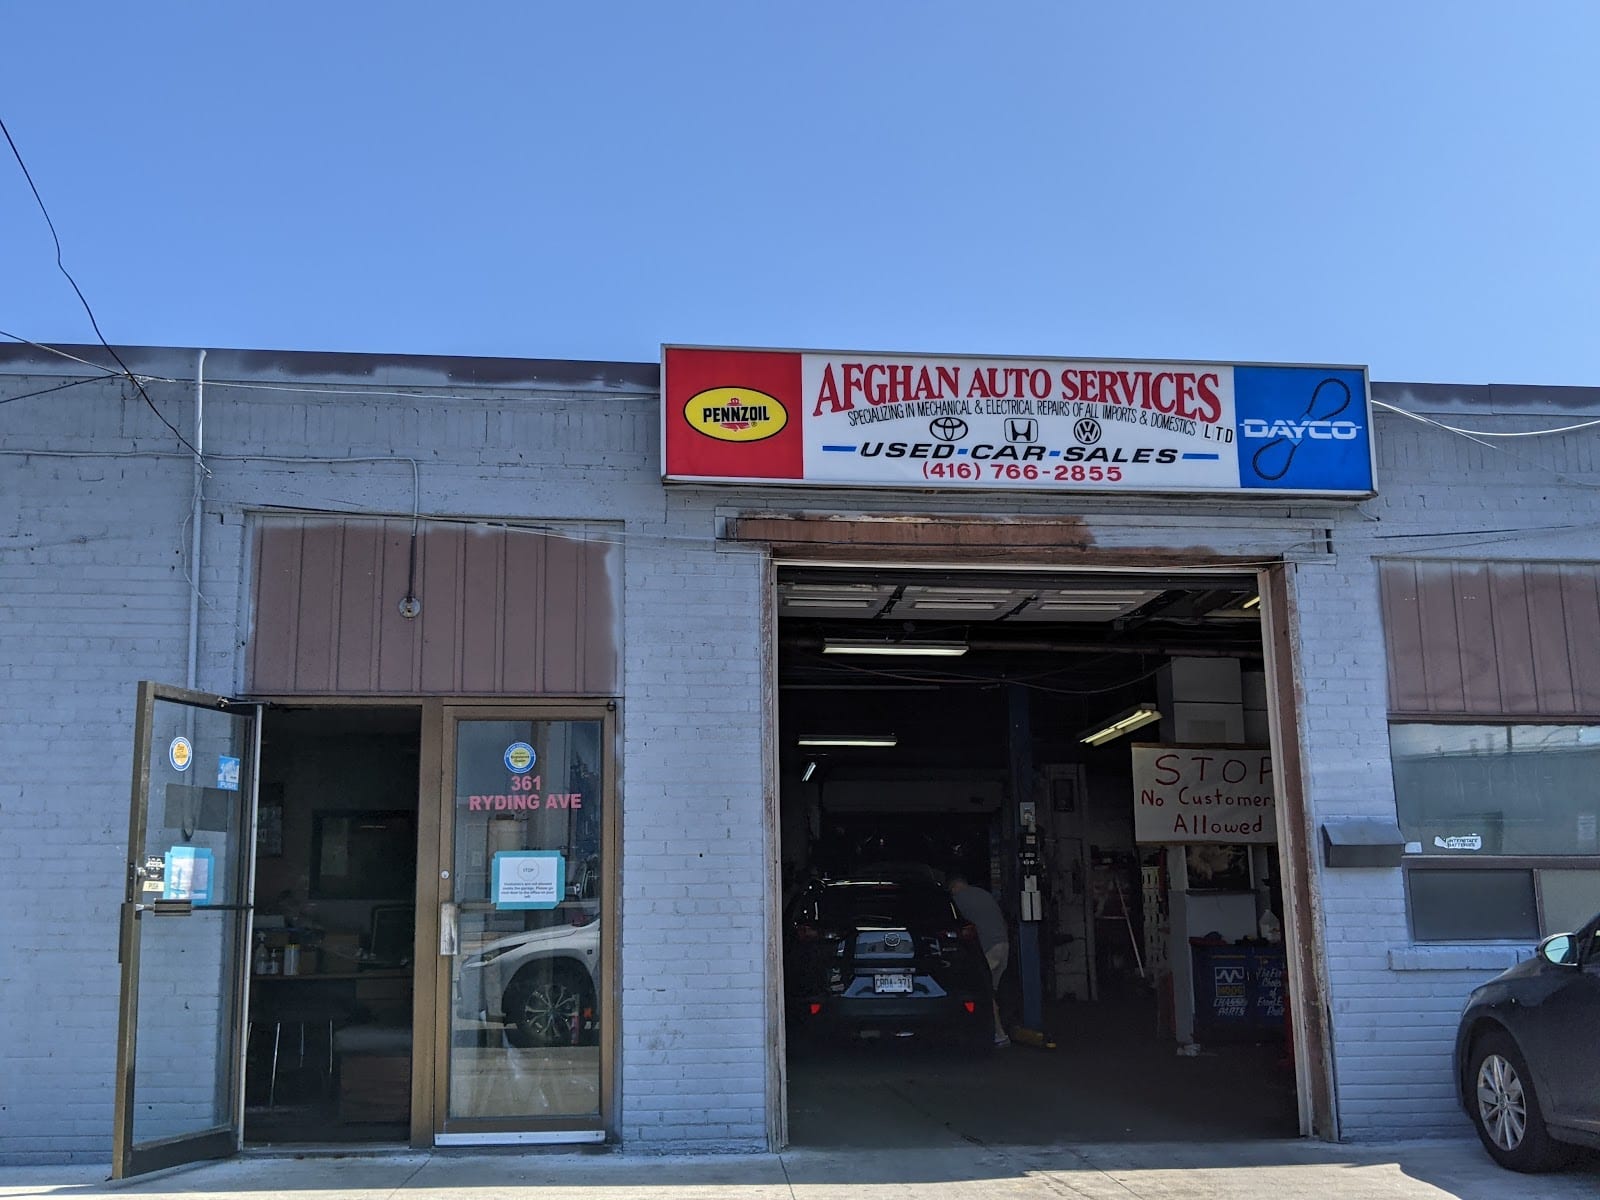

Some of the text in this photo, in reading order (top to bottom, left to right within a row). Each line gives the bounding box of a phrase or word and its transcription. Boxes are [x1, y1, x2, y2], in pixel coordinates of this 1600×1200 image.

[812, 362, 1222, 424] AFGHAN AUTO SERVICES
[703, 406, 770, 423] PENNZOIL
[847, 399, 1197, 437] SPECIALIZING IN MECHANICAL & ELECTRICAL REPAIRS OF ALL IMPORTS & DOMESTICS
[1204, 423, 1234, 443] LTD
[1243, 418, 1357, 440] DAYCO
[860, 442, 1178, 464] USED CAR SALES
[922, 461, 1122, 482] (416) 766-2855
[1155, 754, 1272, 786] STOP
[511, 776, 541, 790] 361
[469, 794, 582, 811] RYDING AVE
[1141, 789, 1164, 807] No
[1173, 813, 1263, 835] Allowed
